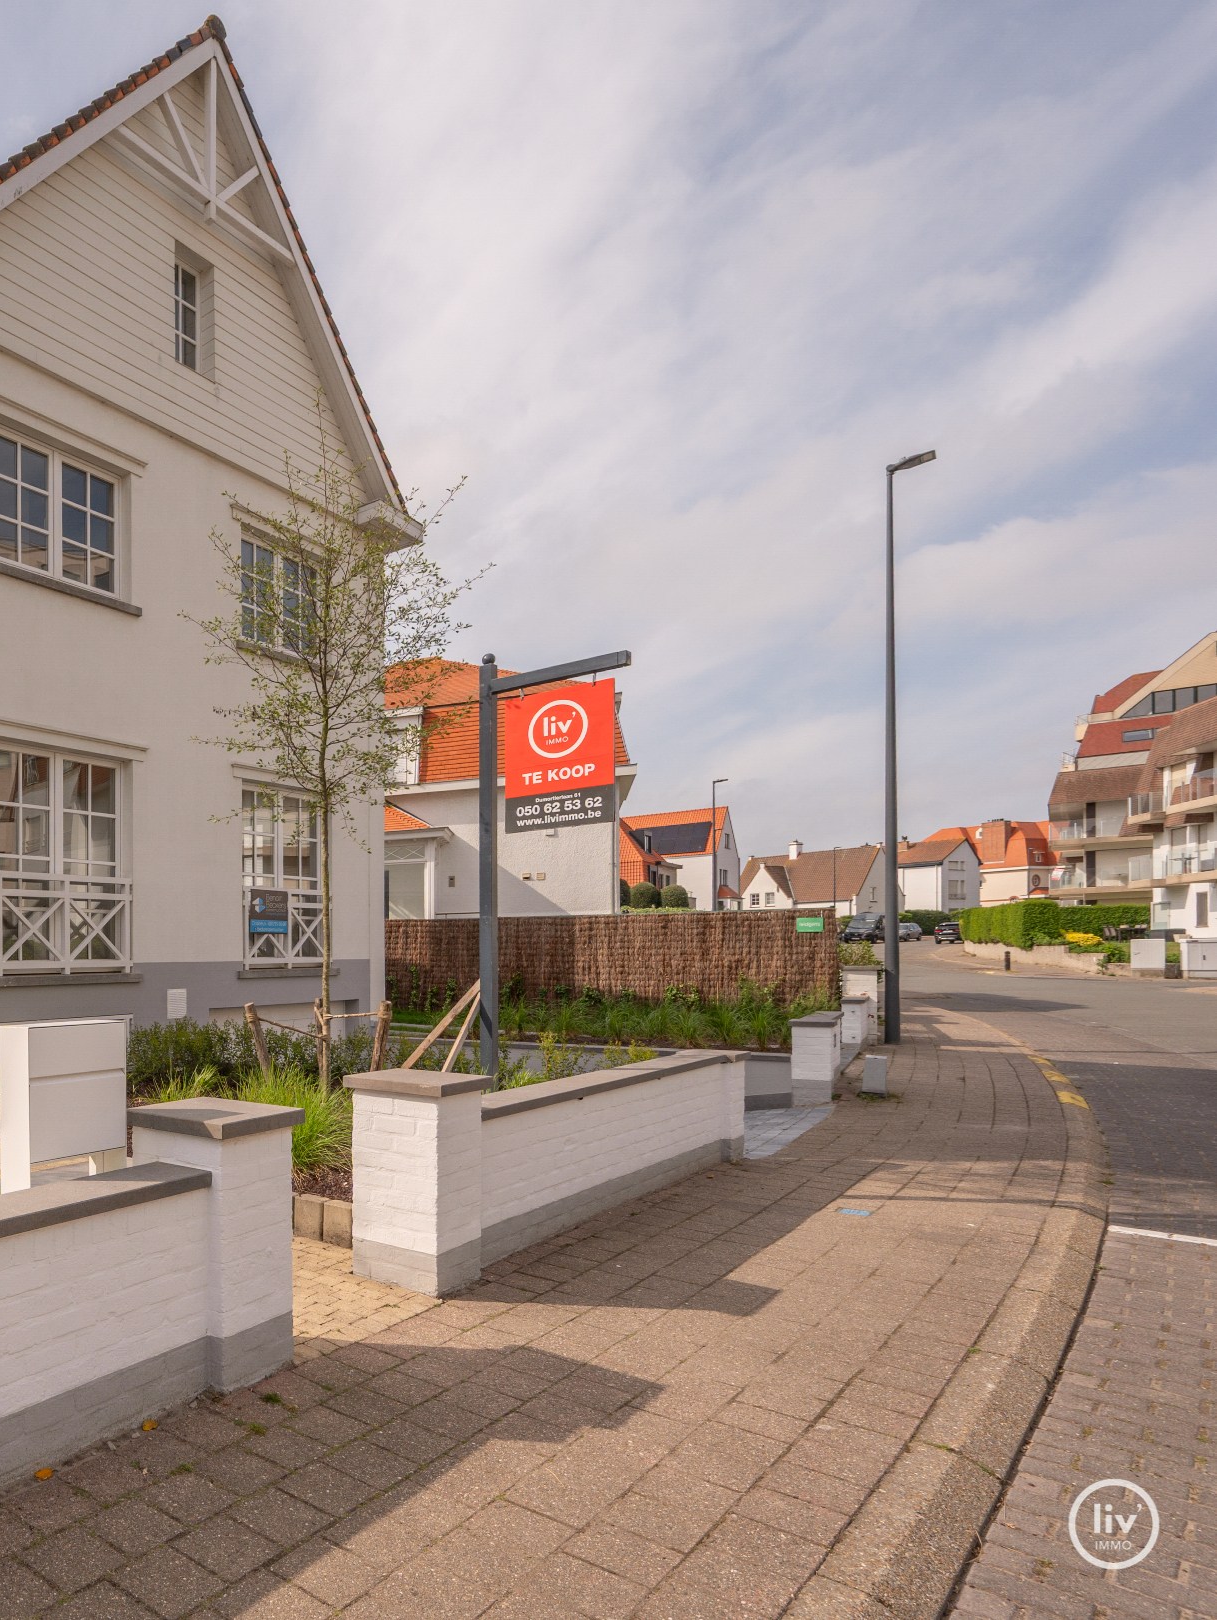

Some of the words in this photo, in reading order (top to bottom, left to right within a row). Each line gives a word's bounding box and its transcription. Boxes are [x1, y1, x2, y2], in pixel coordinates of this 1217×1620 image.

[546, 736, 569, 745] IMMO
[522, 771, 542, 786] TE
[548, 763, 596, 782] KOOP
[516, 805, 541, 817] 050
[544, 802, 561, 813] 62
[564, 799, 581, 811] 53
[585, 796, 603, 808] 62
[516, 810, 602, 827] www.livimmo.be
